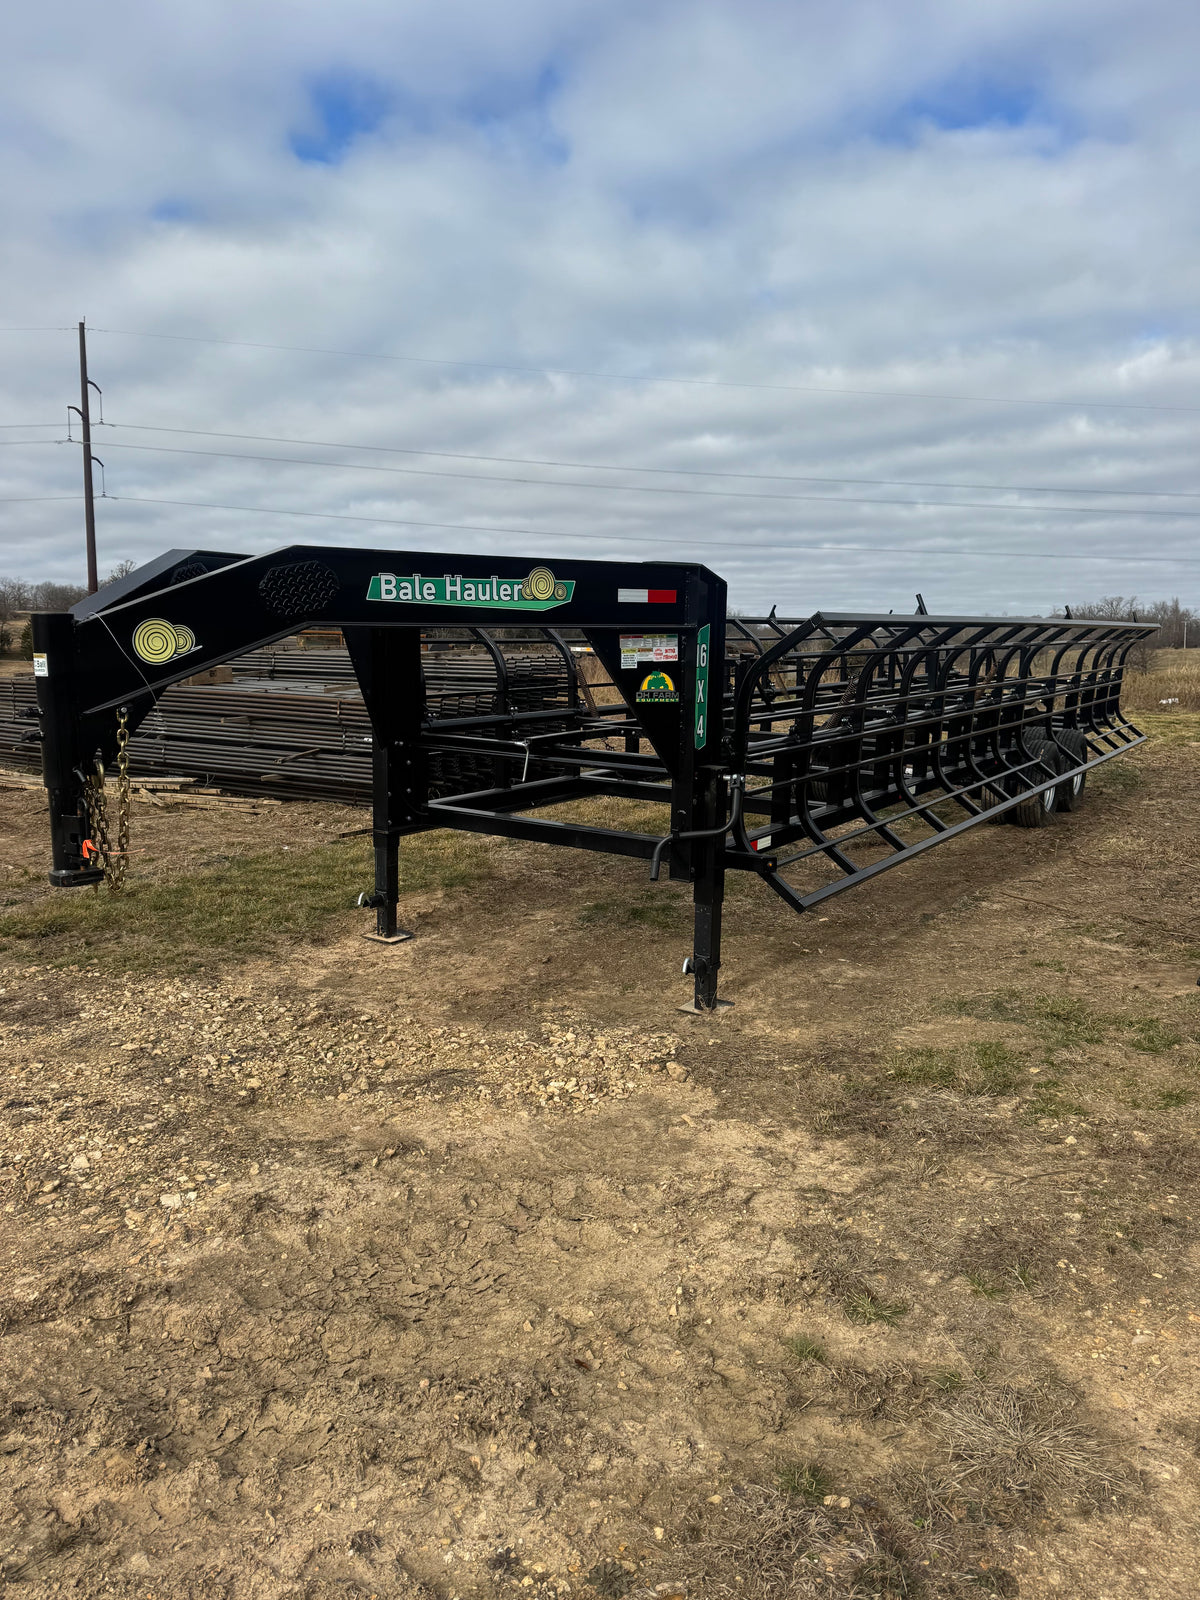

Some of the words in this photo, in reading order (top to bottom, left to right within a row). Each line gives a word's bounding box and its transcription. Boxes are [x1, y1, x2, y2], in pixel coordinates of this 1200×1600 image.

[380, 574, 436, 601] Bale
[445, 576, 523, 602] Hauler
[696, 644, 706, 667] 16
[697, 679, 705, 702] X
[697, 715, 704, 737] 4
